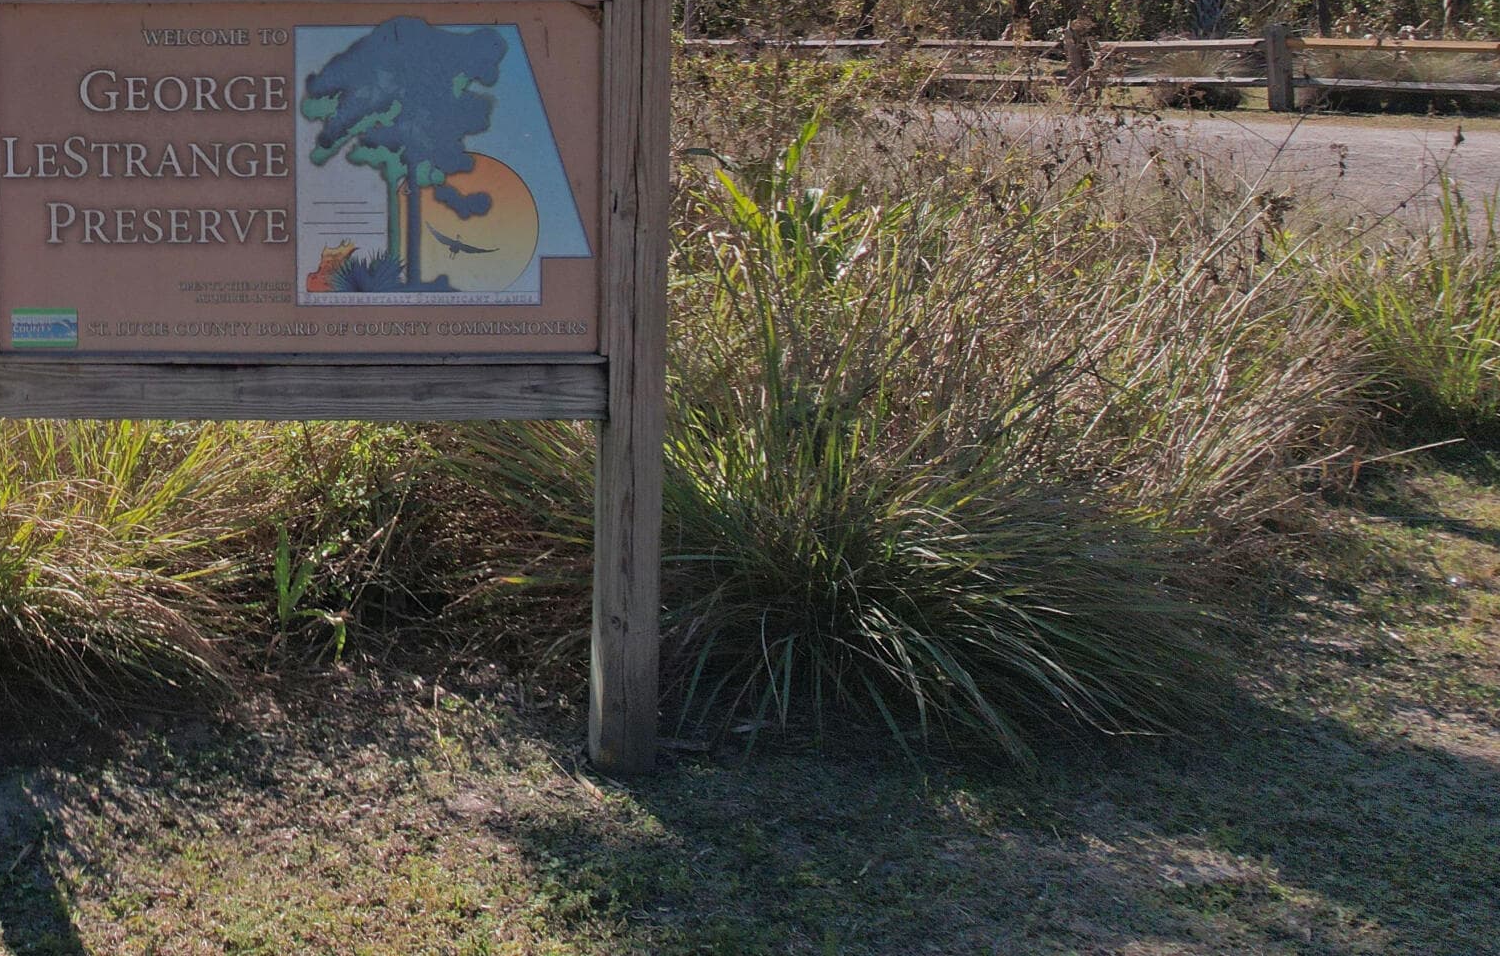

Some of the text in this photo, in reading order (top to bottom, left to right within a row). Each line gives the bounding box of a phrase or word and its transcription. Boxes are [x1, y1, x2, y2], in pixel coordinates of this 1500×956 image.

[142, 28, 289, 45] WELCOME TO
[79, 69, 289, 112] GEORGE
[46, 202, 290, 244] PRESERVE
[86, 321, 588, 337] ST. LUCIE COUNTY BOARD OF COUNTY COMMISSIONERS
